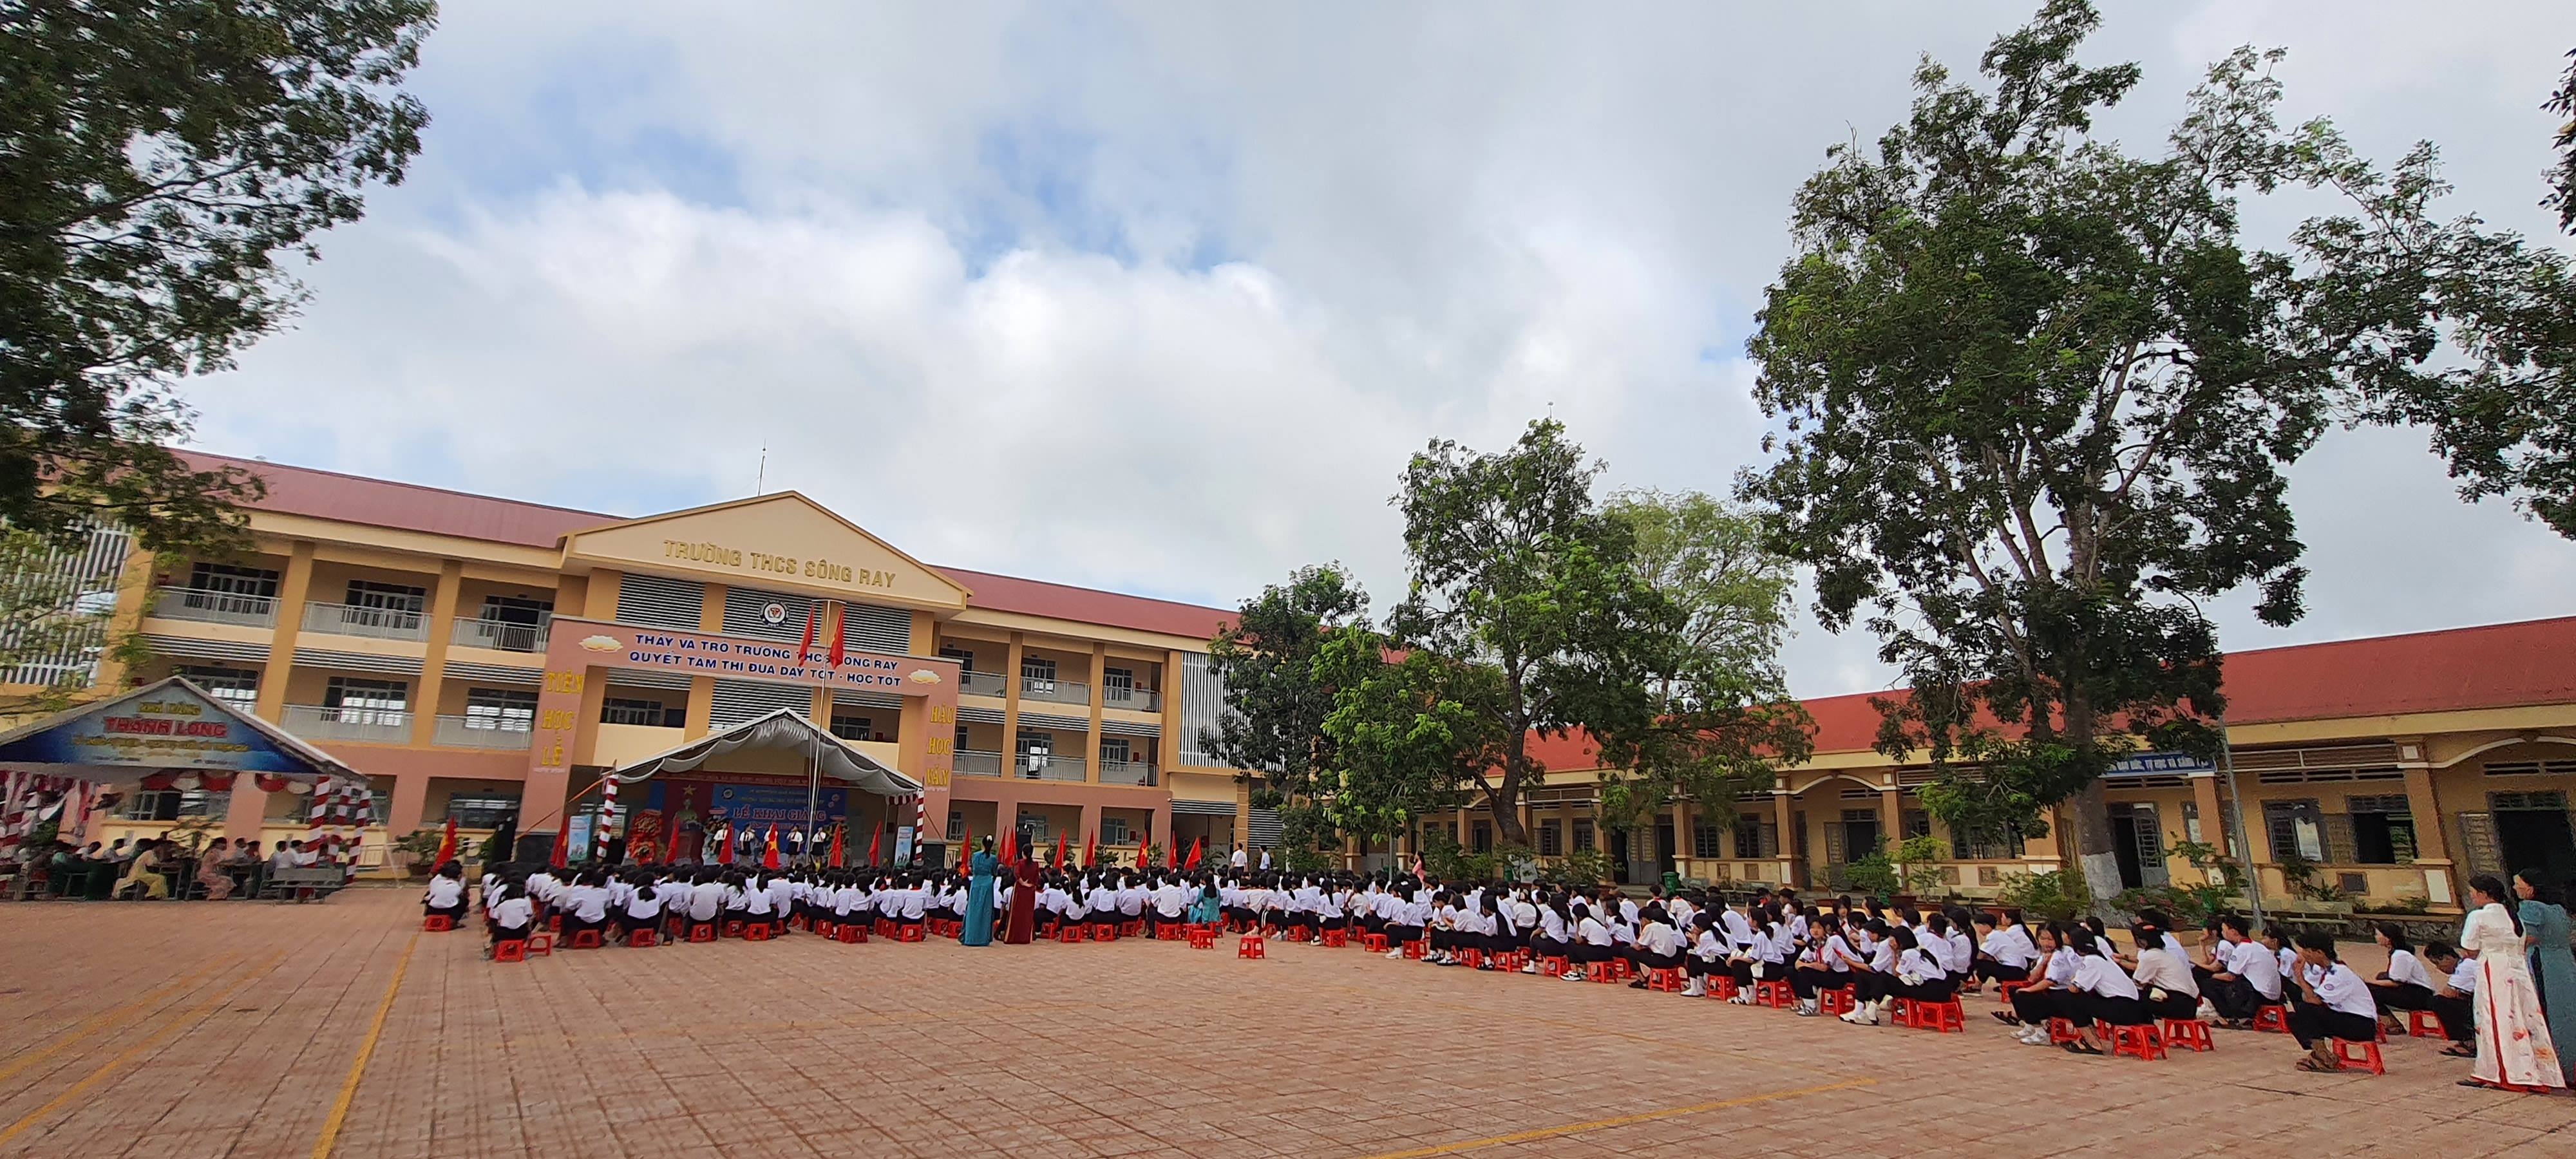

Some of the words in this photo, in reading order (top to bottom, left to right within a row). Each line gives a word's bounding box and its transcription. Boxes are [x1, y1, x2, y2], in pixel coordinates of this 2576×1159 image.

[663, 540, 742, 567] TRƯỜNG
[750, 552, 797, 574] THCS
[804, 559, 851, 581] SÔNG
[858, 568, 896, 588] RAY
[844, 653, 870, 667] ÔNG
[875, 659, 898, 670] RAY
[722, 661, 743, 671] THI
[748, 663, 775, 674] ĐUA
[781, 666, 804, 679] DẠY
[847, 674, 873, 686] HỌC
[542, 710, 574, 733] HỌC
[931, 702, 954, 727] HẬU
[175, 721, 227, 738] LONG
[927, 737, 951, 759] HỌC
[733, 804, 750, 819] LỄ
[752, 807, 786, 820] KHAI
